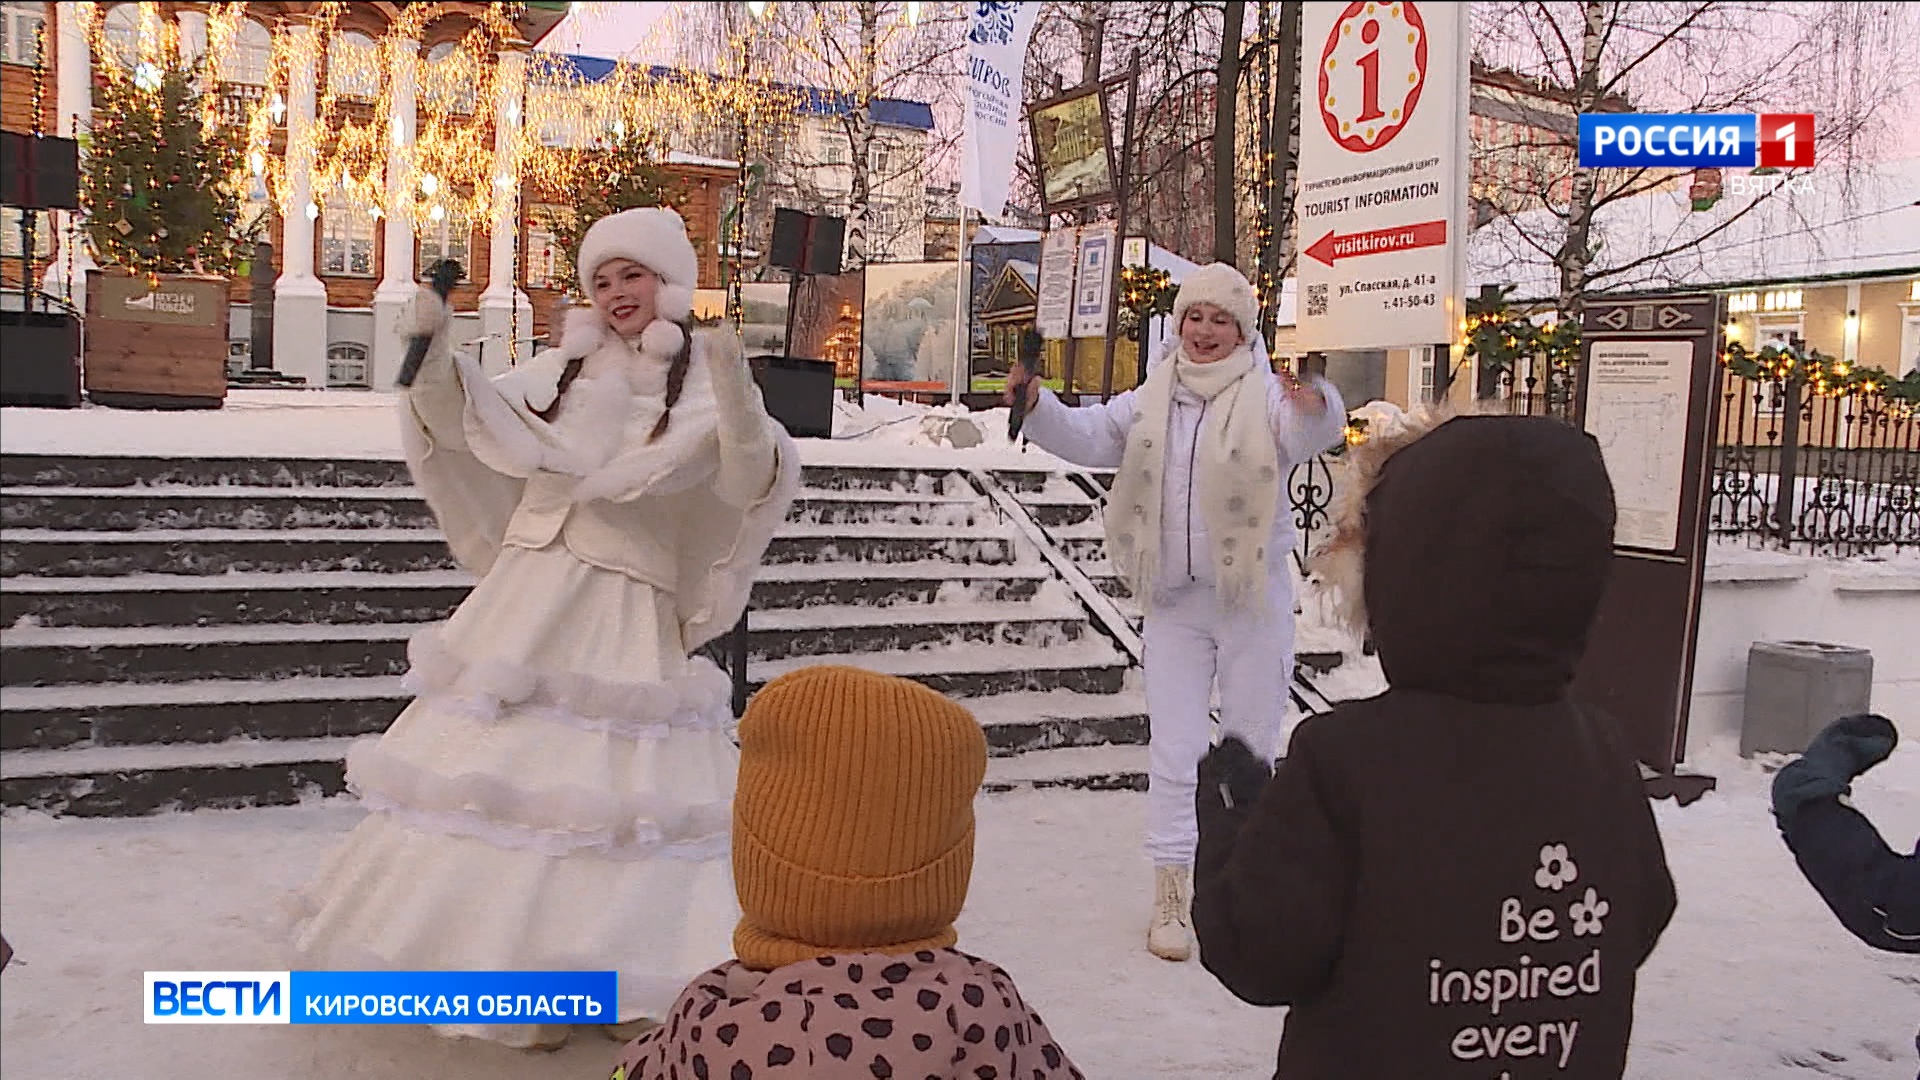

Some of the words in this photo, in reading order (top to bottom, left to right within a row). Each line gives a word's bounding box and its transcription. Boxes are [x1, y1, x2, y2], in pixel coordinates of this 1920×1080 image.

[1415, 157, 1440, 171] ЦЕНТР
[1305, 197, 1350, 217] TOURIST
[1355, 181, 1439, 209] INFORMATION
[1334, 231, 1416, 255] visitkirov.ru
[1339, 283, 1353, 297] ул.
[1392, 293, 1436, 308] 41-50-43
[1500, 897, 1559, 943] Be
[1430, 949, 1600, 1015] inspired
[1451, 1021, 1579, 1068] every
